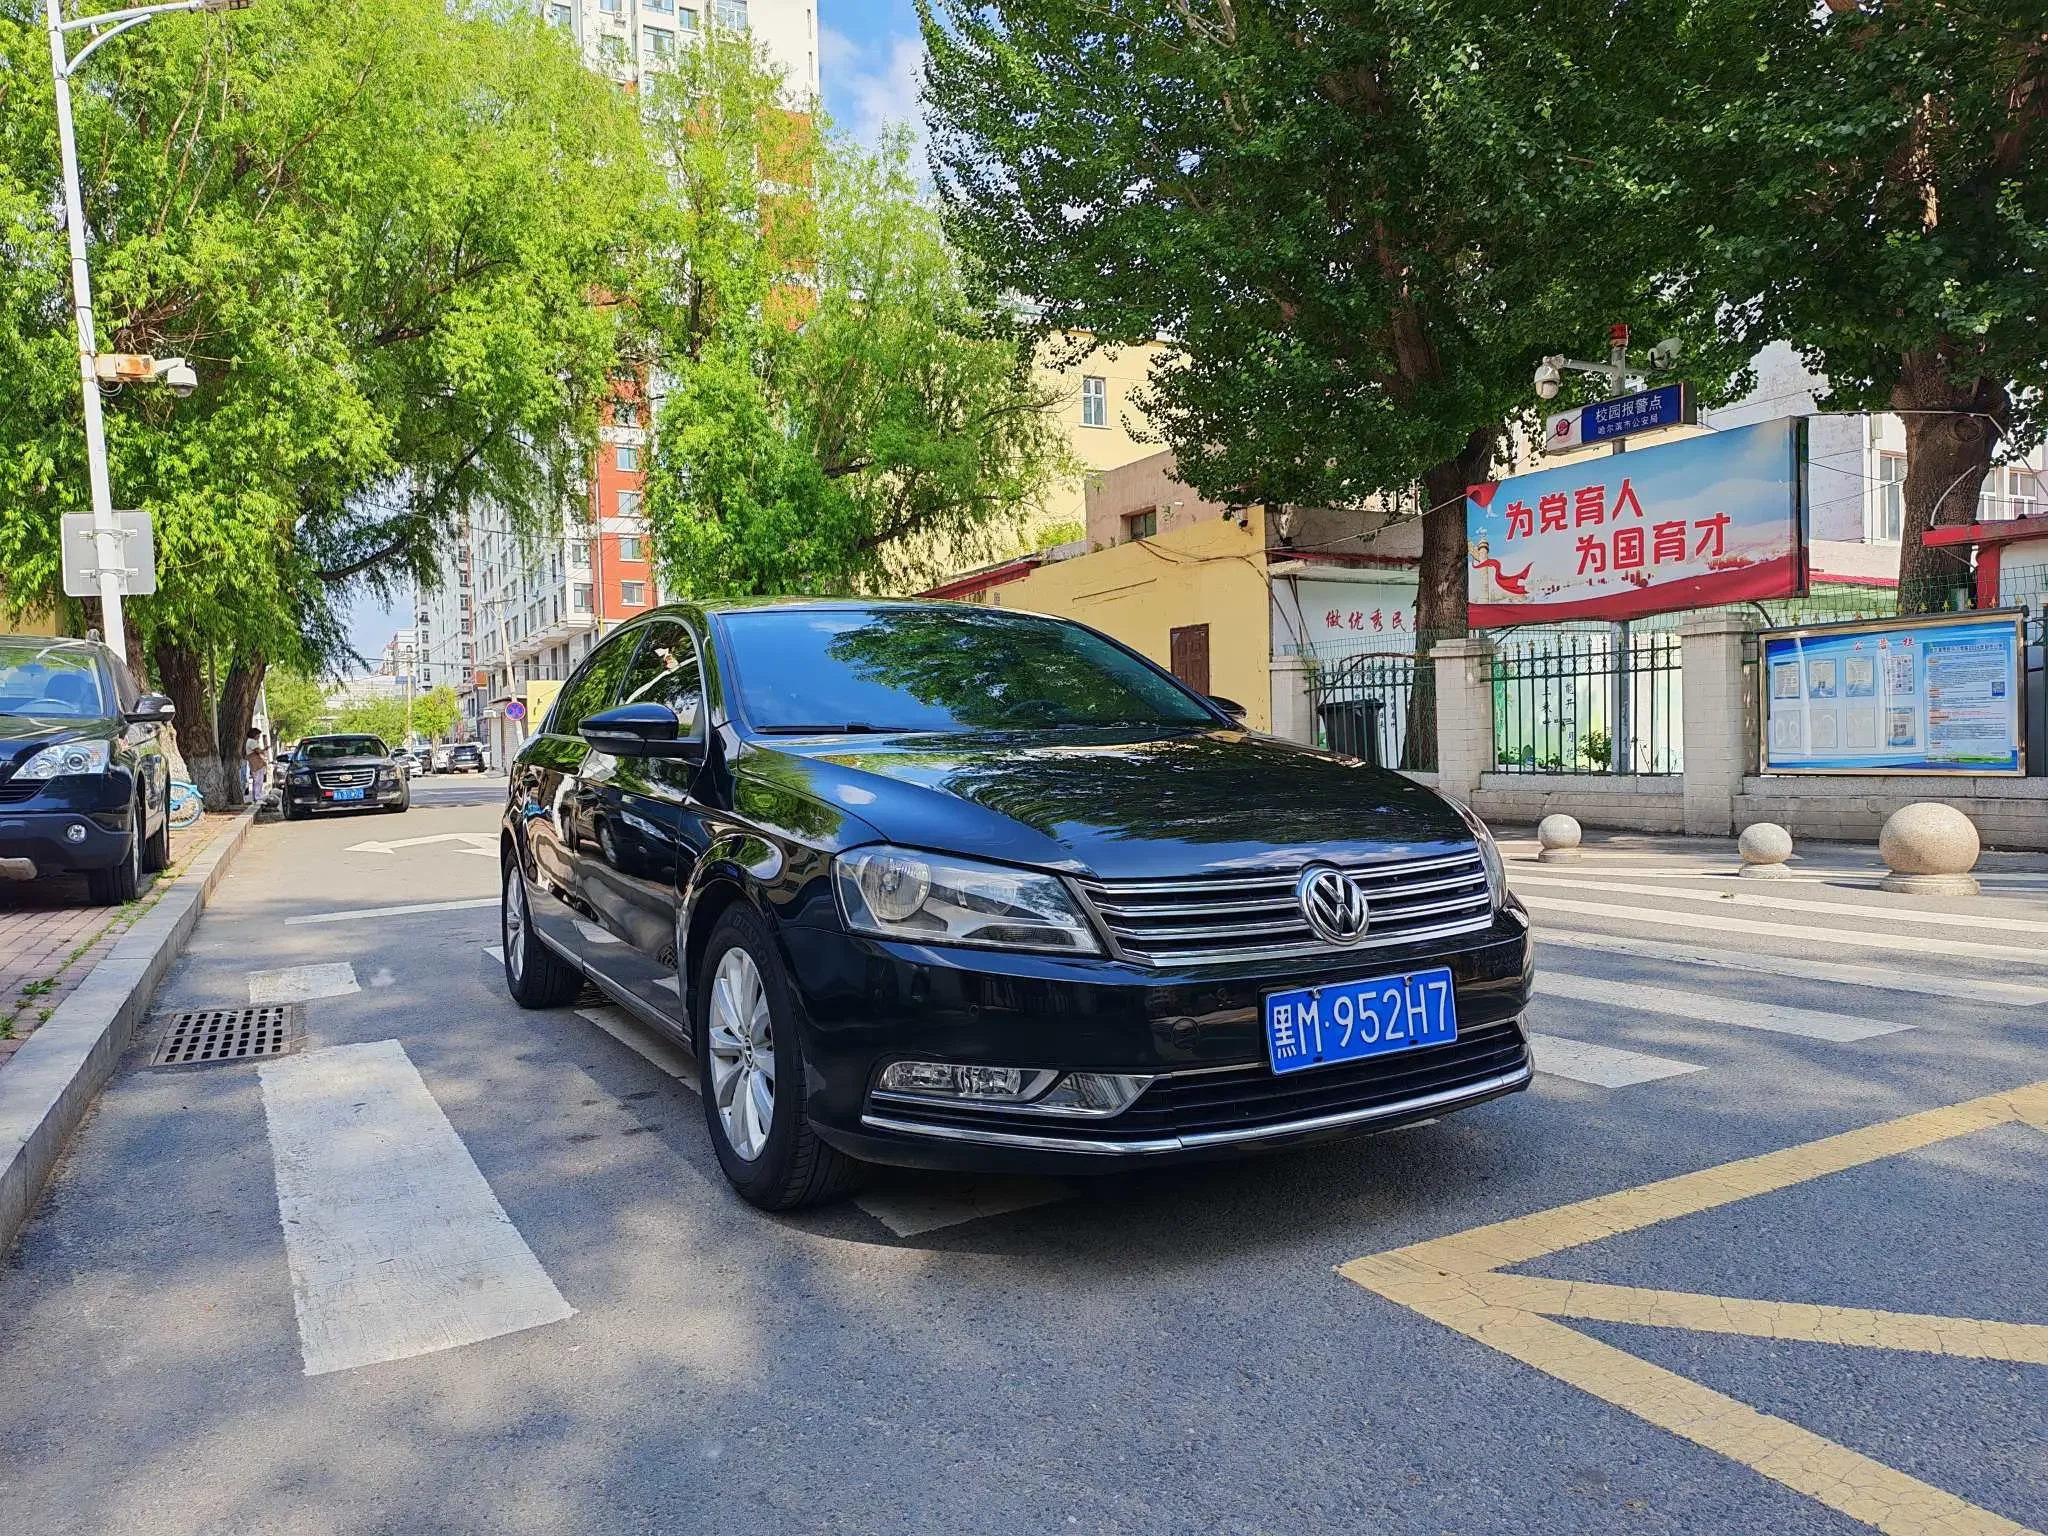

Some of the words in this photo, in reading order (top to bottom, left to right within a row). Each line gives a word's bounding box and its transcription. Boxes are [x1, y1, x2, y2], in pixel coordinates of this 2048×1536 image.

[1595, 394, 1663, 423] 校园报警点
[1597, 413, 1659, 435] 哈尔滨市公安局
[1505, 477, 1644, 541] 为党育人
[1575, 511, 1732, 576] 为国育才
